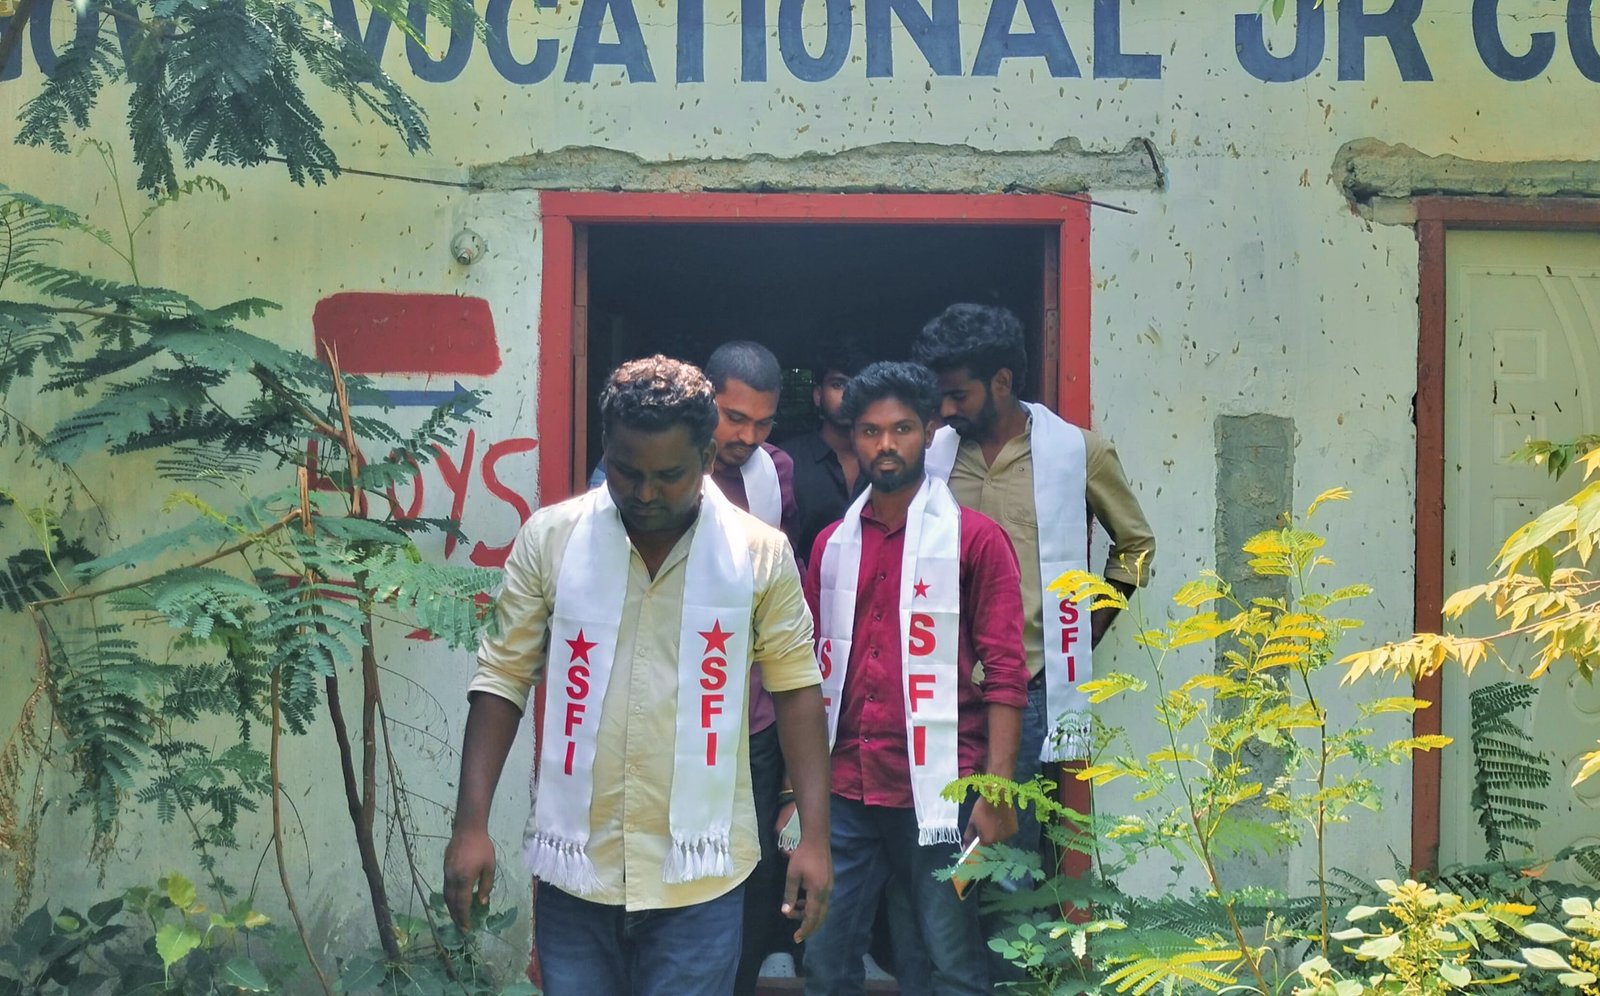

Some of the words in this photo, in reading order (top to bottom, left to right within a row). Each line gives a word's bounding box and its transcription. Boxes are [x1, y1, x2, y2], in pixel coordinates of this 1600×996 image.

[1235, 0, 1433, 83] JR
[908, 613, 936, 766] SFI
[1059, 598, 1079, 682] SFI
[564, 665, 590, 776] SFI
[699, 656, 728, 766] SFI
